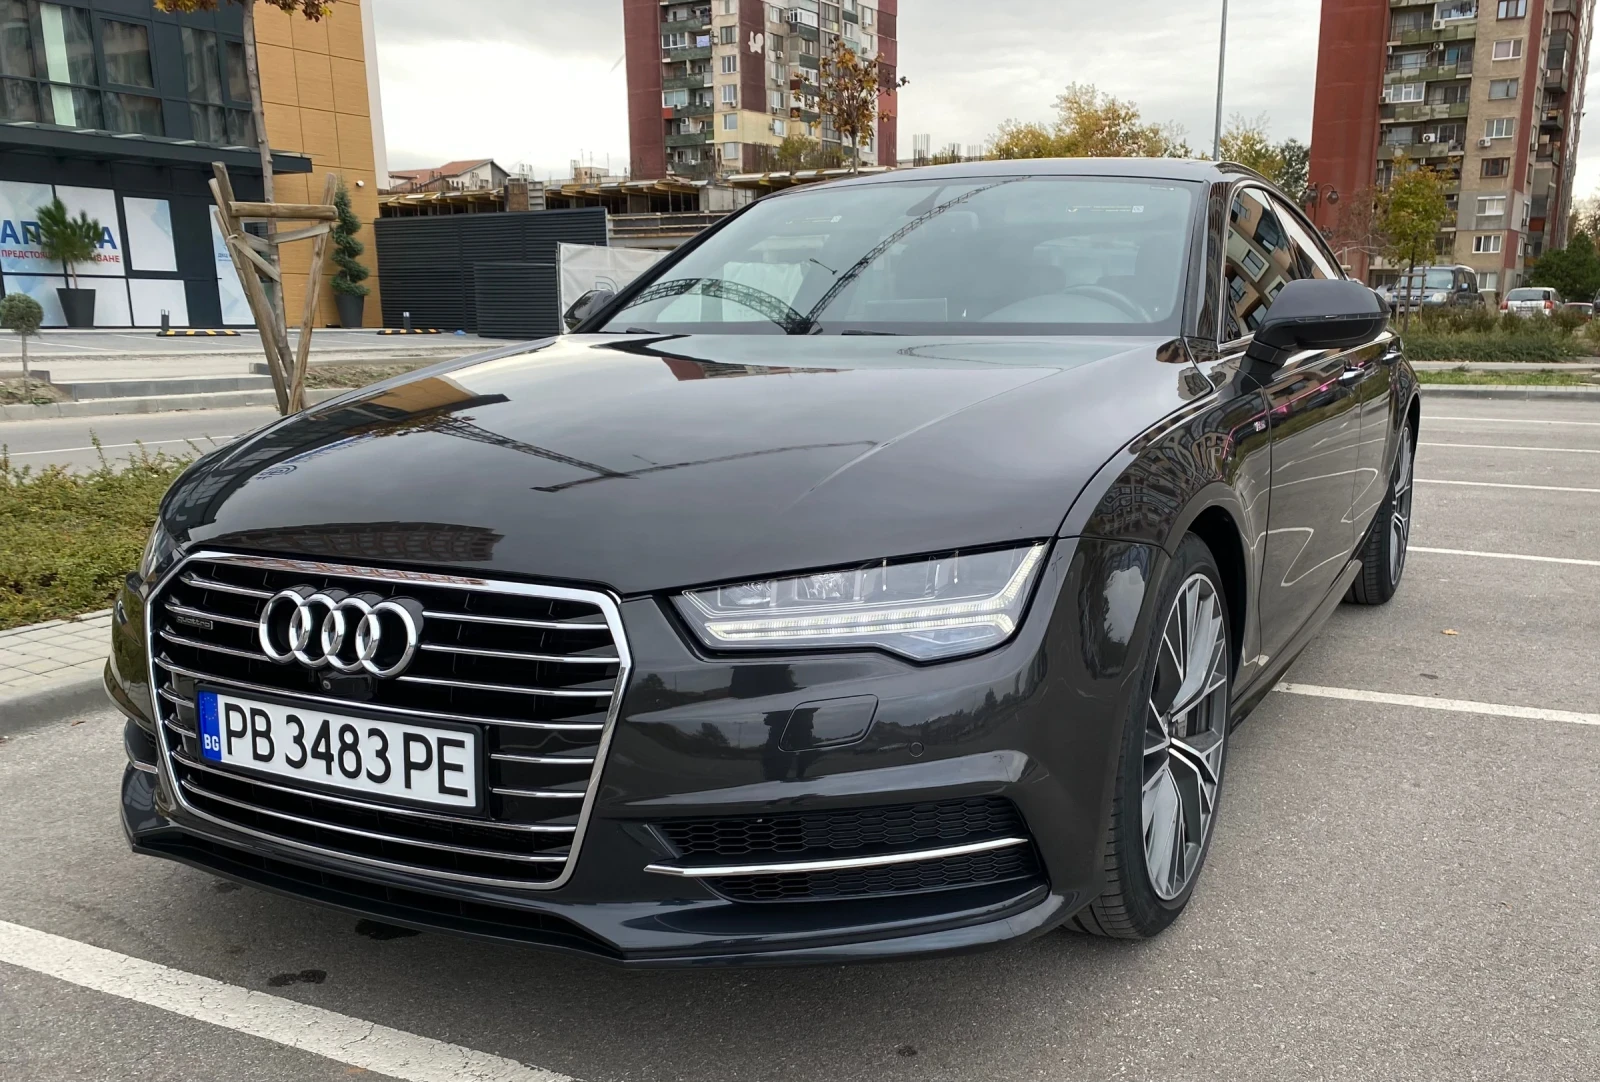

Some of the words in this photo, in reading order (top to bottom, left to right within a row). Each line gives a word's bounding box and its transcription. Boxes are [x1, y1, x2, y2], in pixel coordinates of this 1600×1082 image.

[204, 733, 220, 751] BG
[224, 702, 275, 763] PB
[285, 714, 391, 784] 3483
[402, 732, 469, 798] PE
